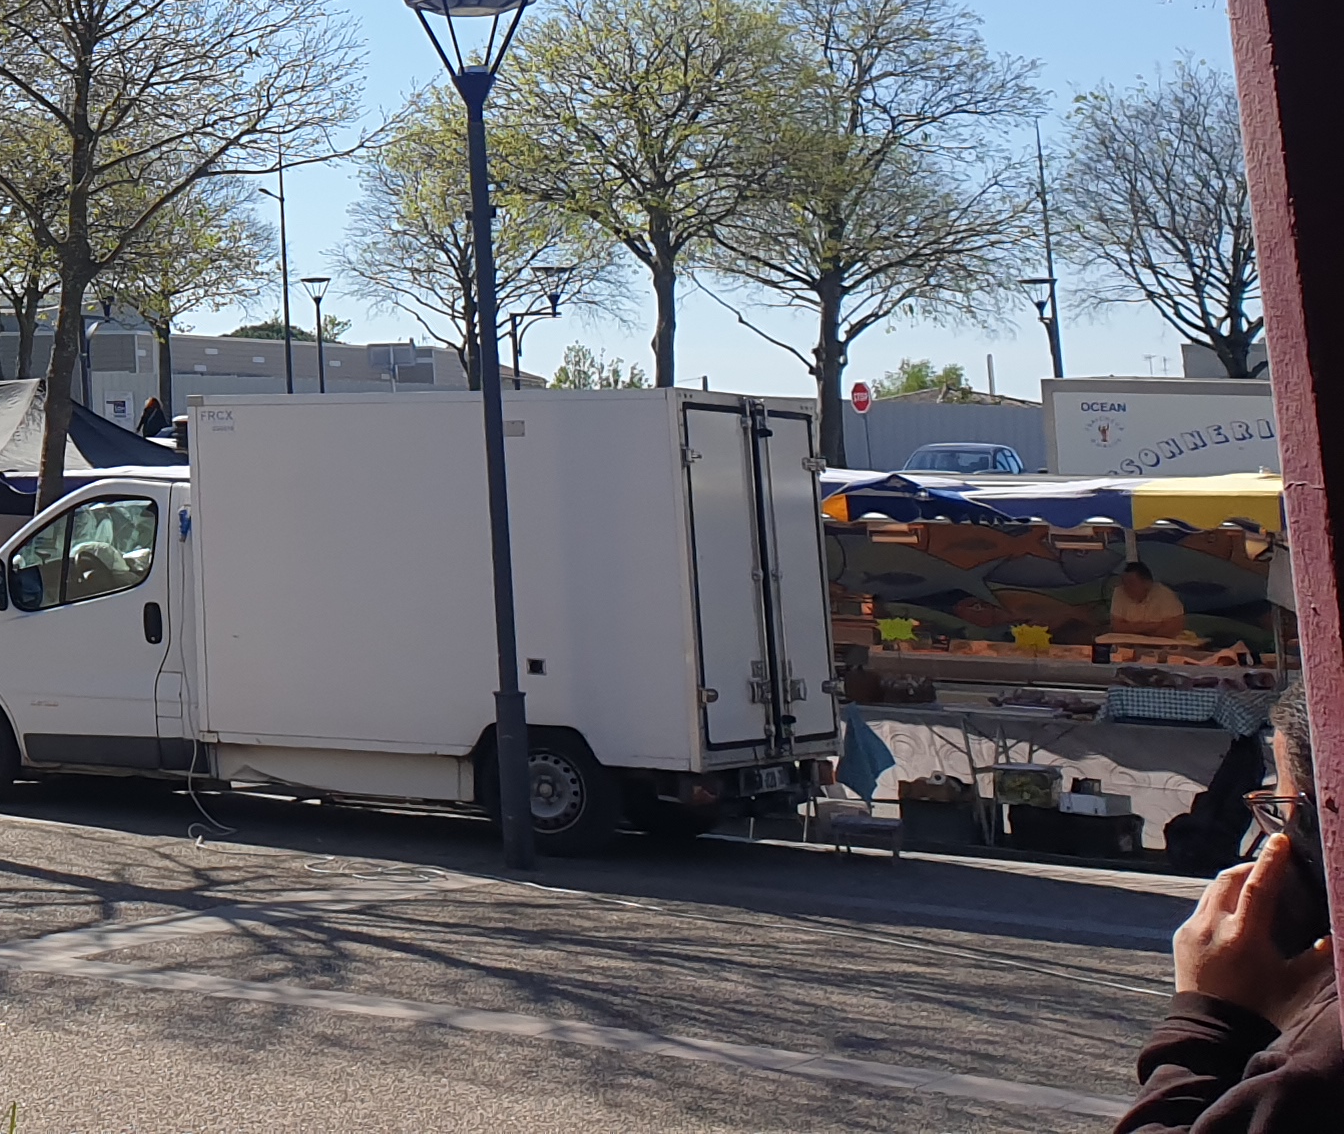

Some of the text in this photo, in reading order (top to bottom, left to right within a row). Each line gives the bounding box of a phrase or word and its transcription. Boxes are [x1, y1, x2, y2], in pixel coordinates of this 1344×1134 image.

[854, 392, 868, 402] STOP
[1080, 401, 1127, 413] OCEAN
[200, 410, 234, 421] FRCX
[1107, 418, 1275, 476] SONNERI
